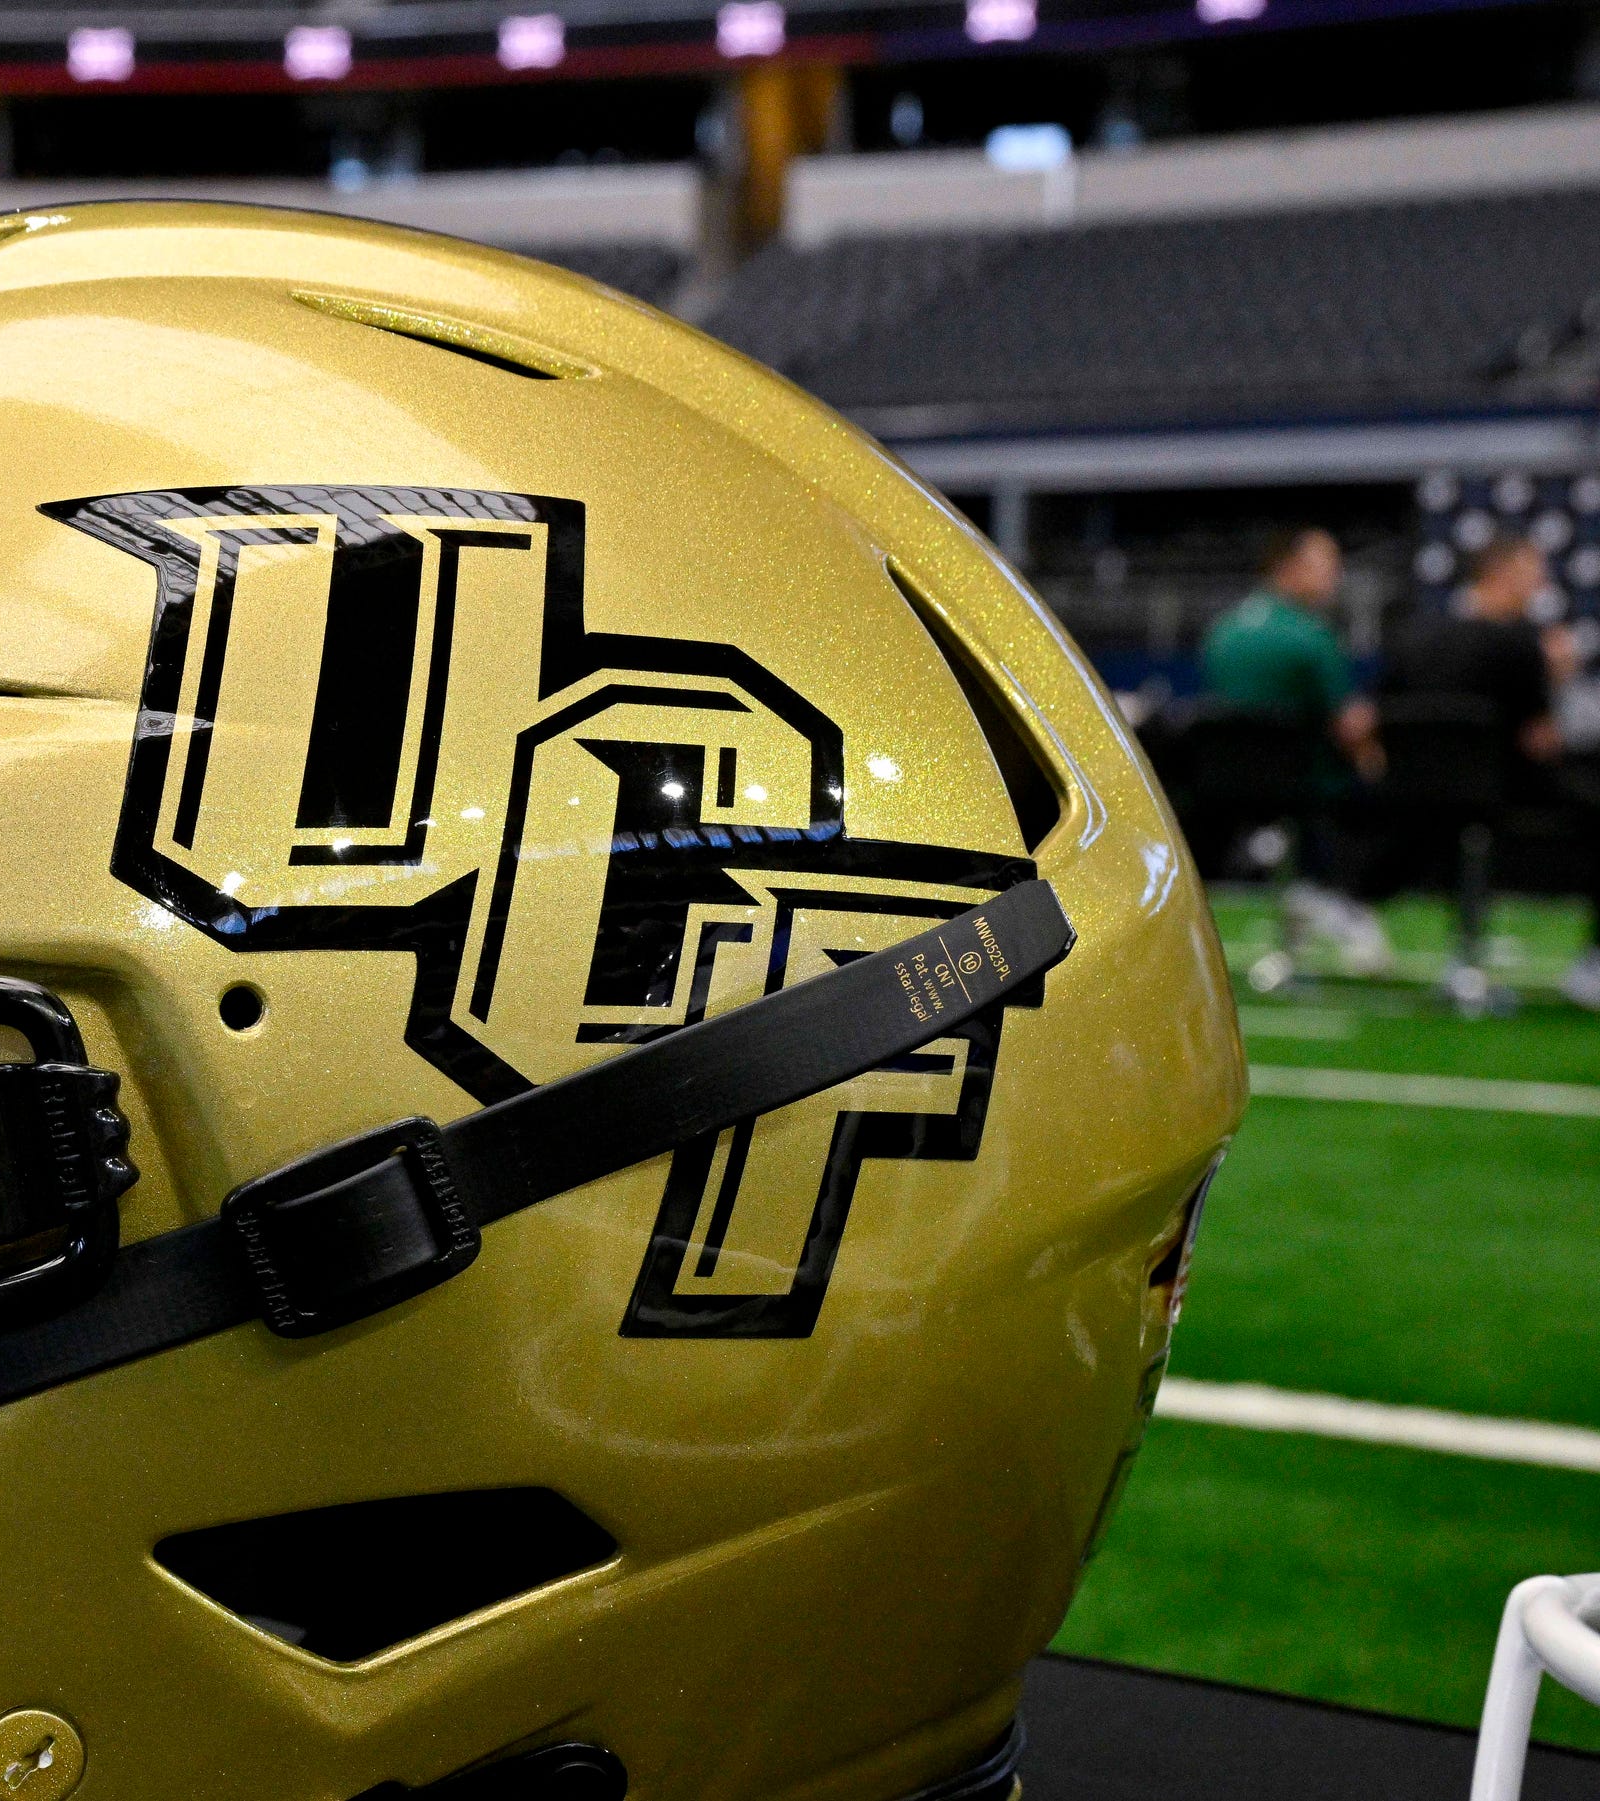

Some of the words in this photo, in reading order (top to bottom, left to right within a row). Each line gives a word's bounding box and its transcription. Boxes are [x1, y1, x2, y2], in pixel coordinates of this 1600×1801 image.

[37, 484, 1044, 1339] UCF
[894, 962, 933, 1022] sstar.legal
[911, 953, 929, 979] Pat.
[923, 979, 945, 1014] www.
[934, 963, 956, 988] CNT
